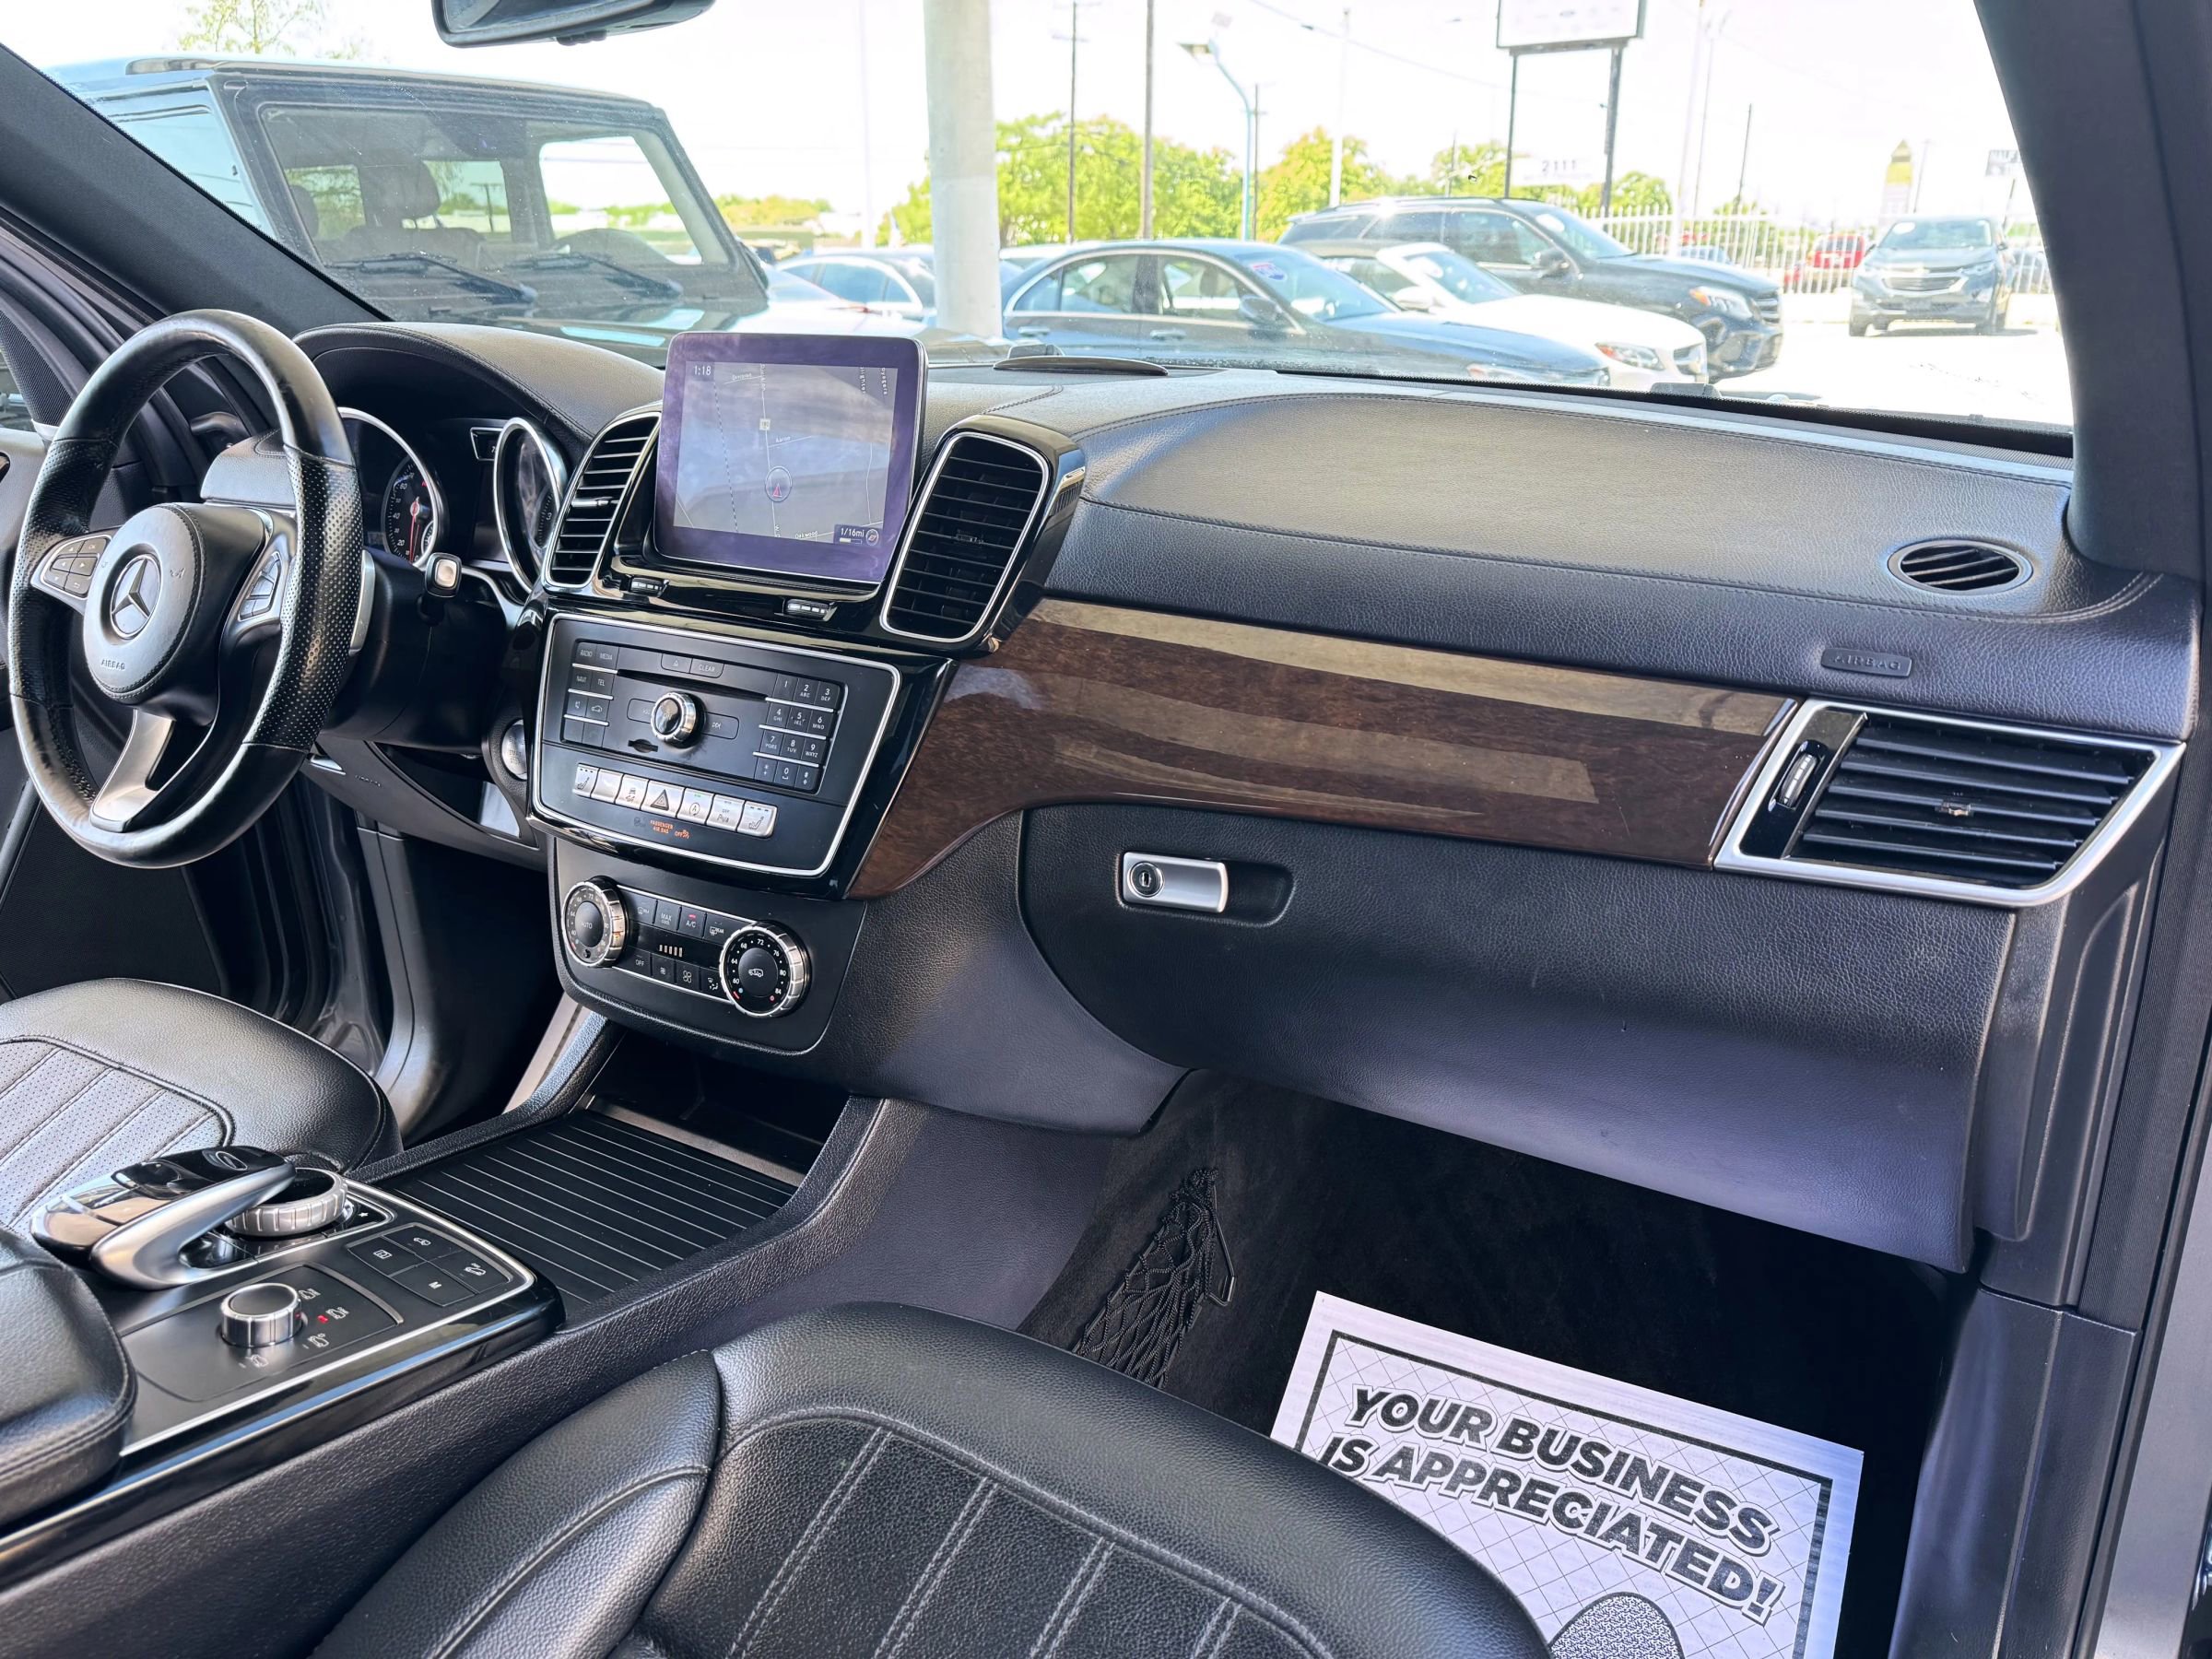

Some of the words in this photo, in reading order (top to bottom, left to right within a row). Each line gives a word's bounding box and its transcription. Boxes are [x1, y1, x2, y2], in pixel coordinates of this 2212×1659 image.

[1541, 159, 1577, 172] 2111
[693, 365, 711, 376] 1:18
[794, 530, 818, 539] Oakwood
[841, 527, 865, 537] 1/16mi
[580, 649, 593, 657] RADIO
[599, 653, 613, 661] MEDIA
[101, 659, 125, 670] AIRBAG
[1833, 655, 1901, 671] AIRBAG
[699, 664, 716, 673] CLEAR
[597, 678, 606, 687] TEL
[650, 819, 674, 830] PASSENGER
[661, 912, 672, 922] MAX
[1347, 1386, 1495, 1447] YOUR
[1495, 1417, 1774, 1551] BUSINESS
[1318, 1436, 1375, 1473] IS
[1370, 1444, 1780, 1619] APPRECIATED!
